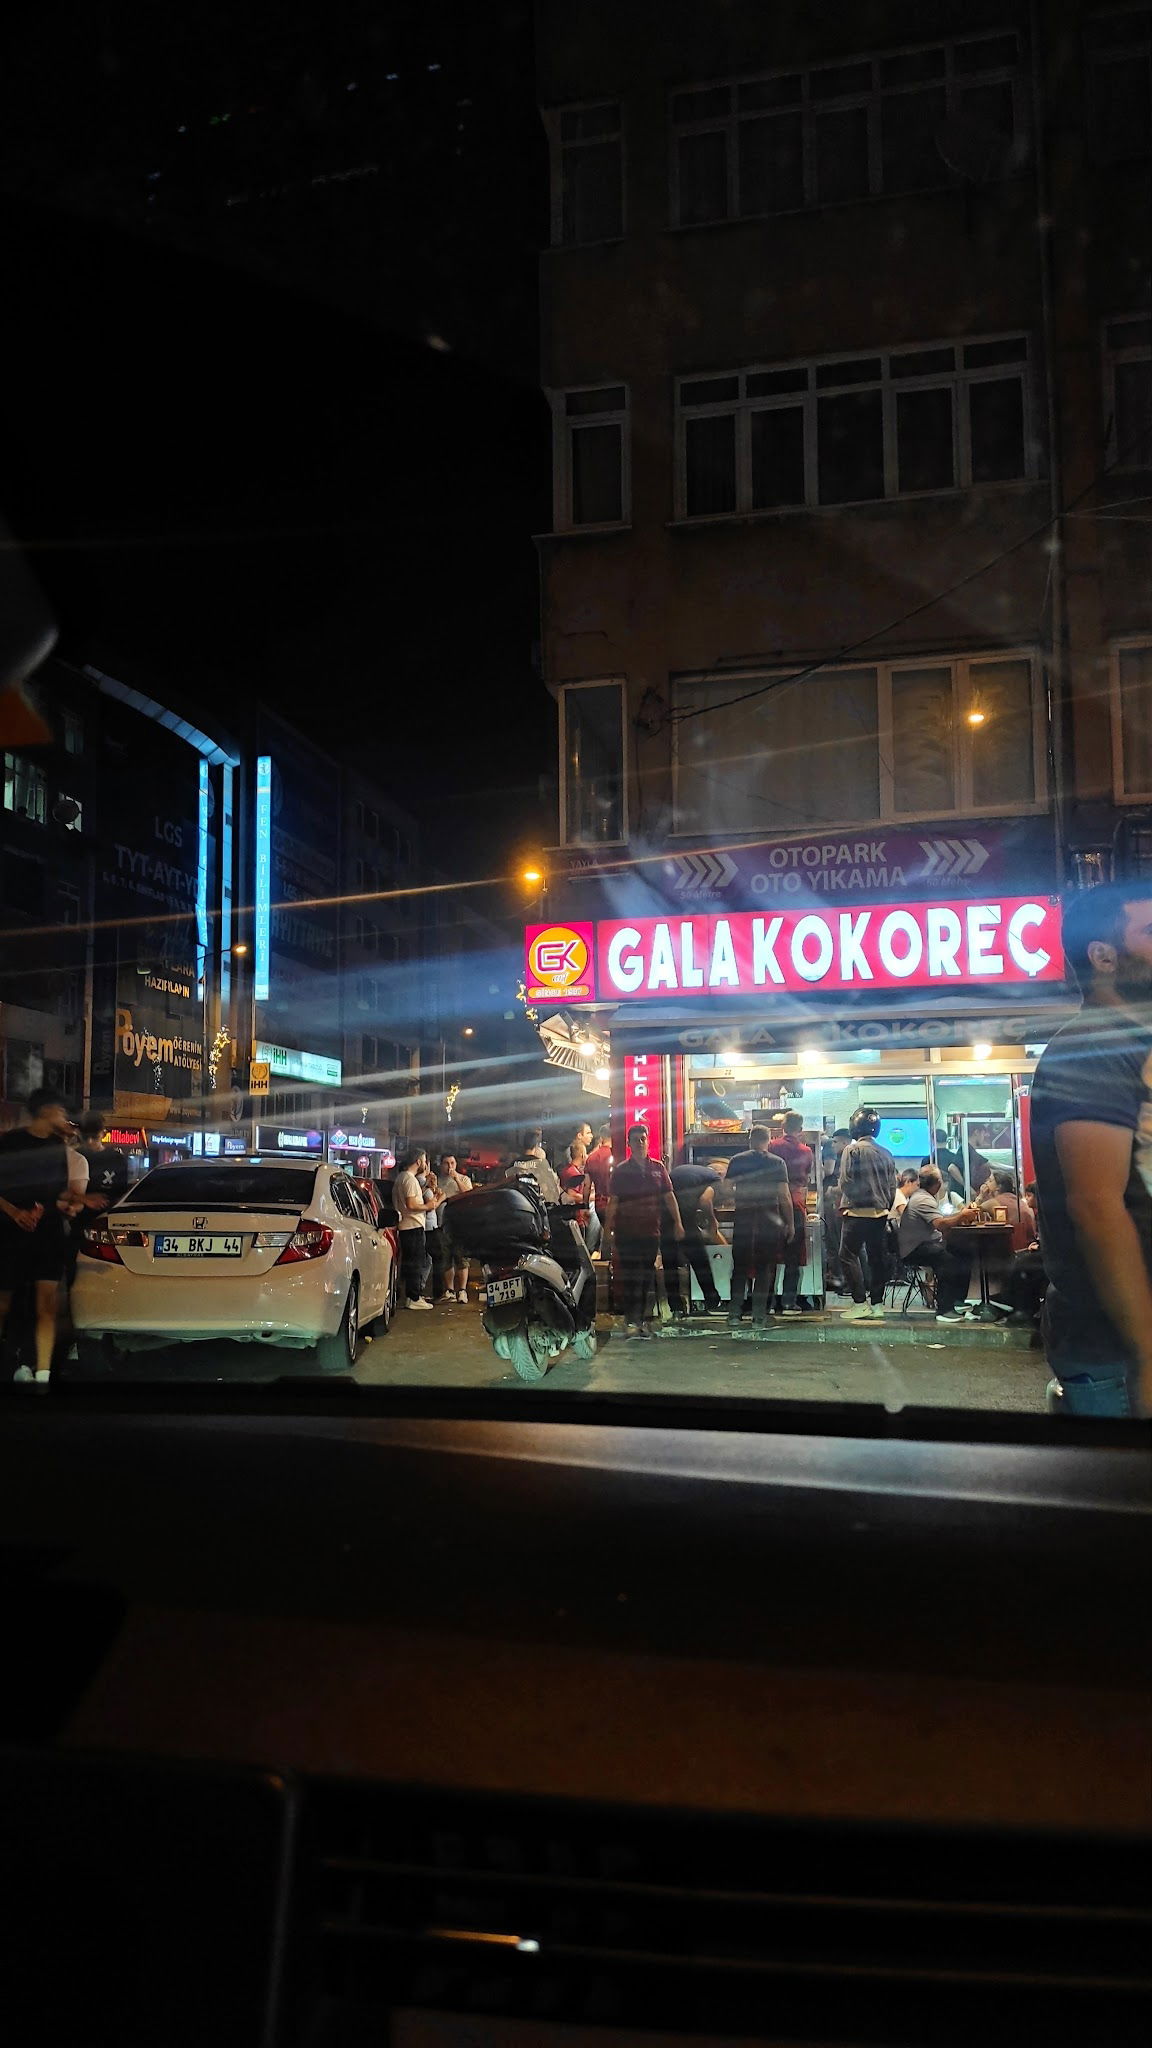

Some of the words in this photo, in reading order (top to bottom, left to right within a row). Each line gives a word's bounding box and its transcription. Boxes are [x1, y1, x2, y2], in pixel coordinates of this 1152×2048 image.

[155, 815, 183, 848] LGS
[769, 841, 887, 869] OTOPARK
[750, 871, 801, 894] OTO
[807, 866, 908, 891] YIKAMA
[607, 919, 740, 992] GALA
[752, 903, 1051, 985] KOKOREÇ
[678, 1026, 776, 1049] GALA
[831, 1018, 1027, 1044] KOKOREÇ
[163, 1238, 179, 1252] 34
[188, 1238, 213, 1252] BKJ
[224, 1238, 239, 1252] 44
[489, 1284, 500, 1294] 34
[503, 1279, 520, 1290] BFT
[500, 1289, 516, 1301] 719
